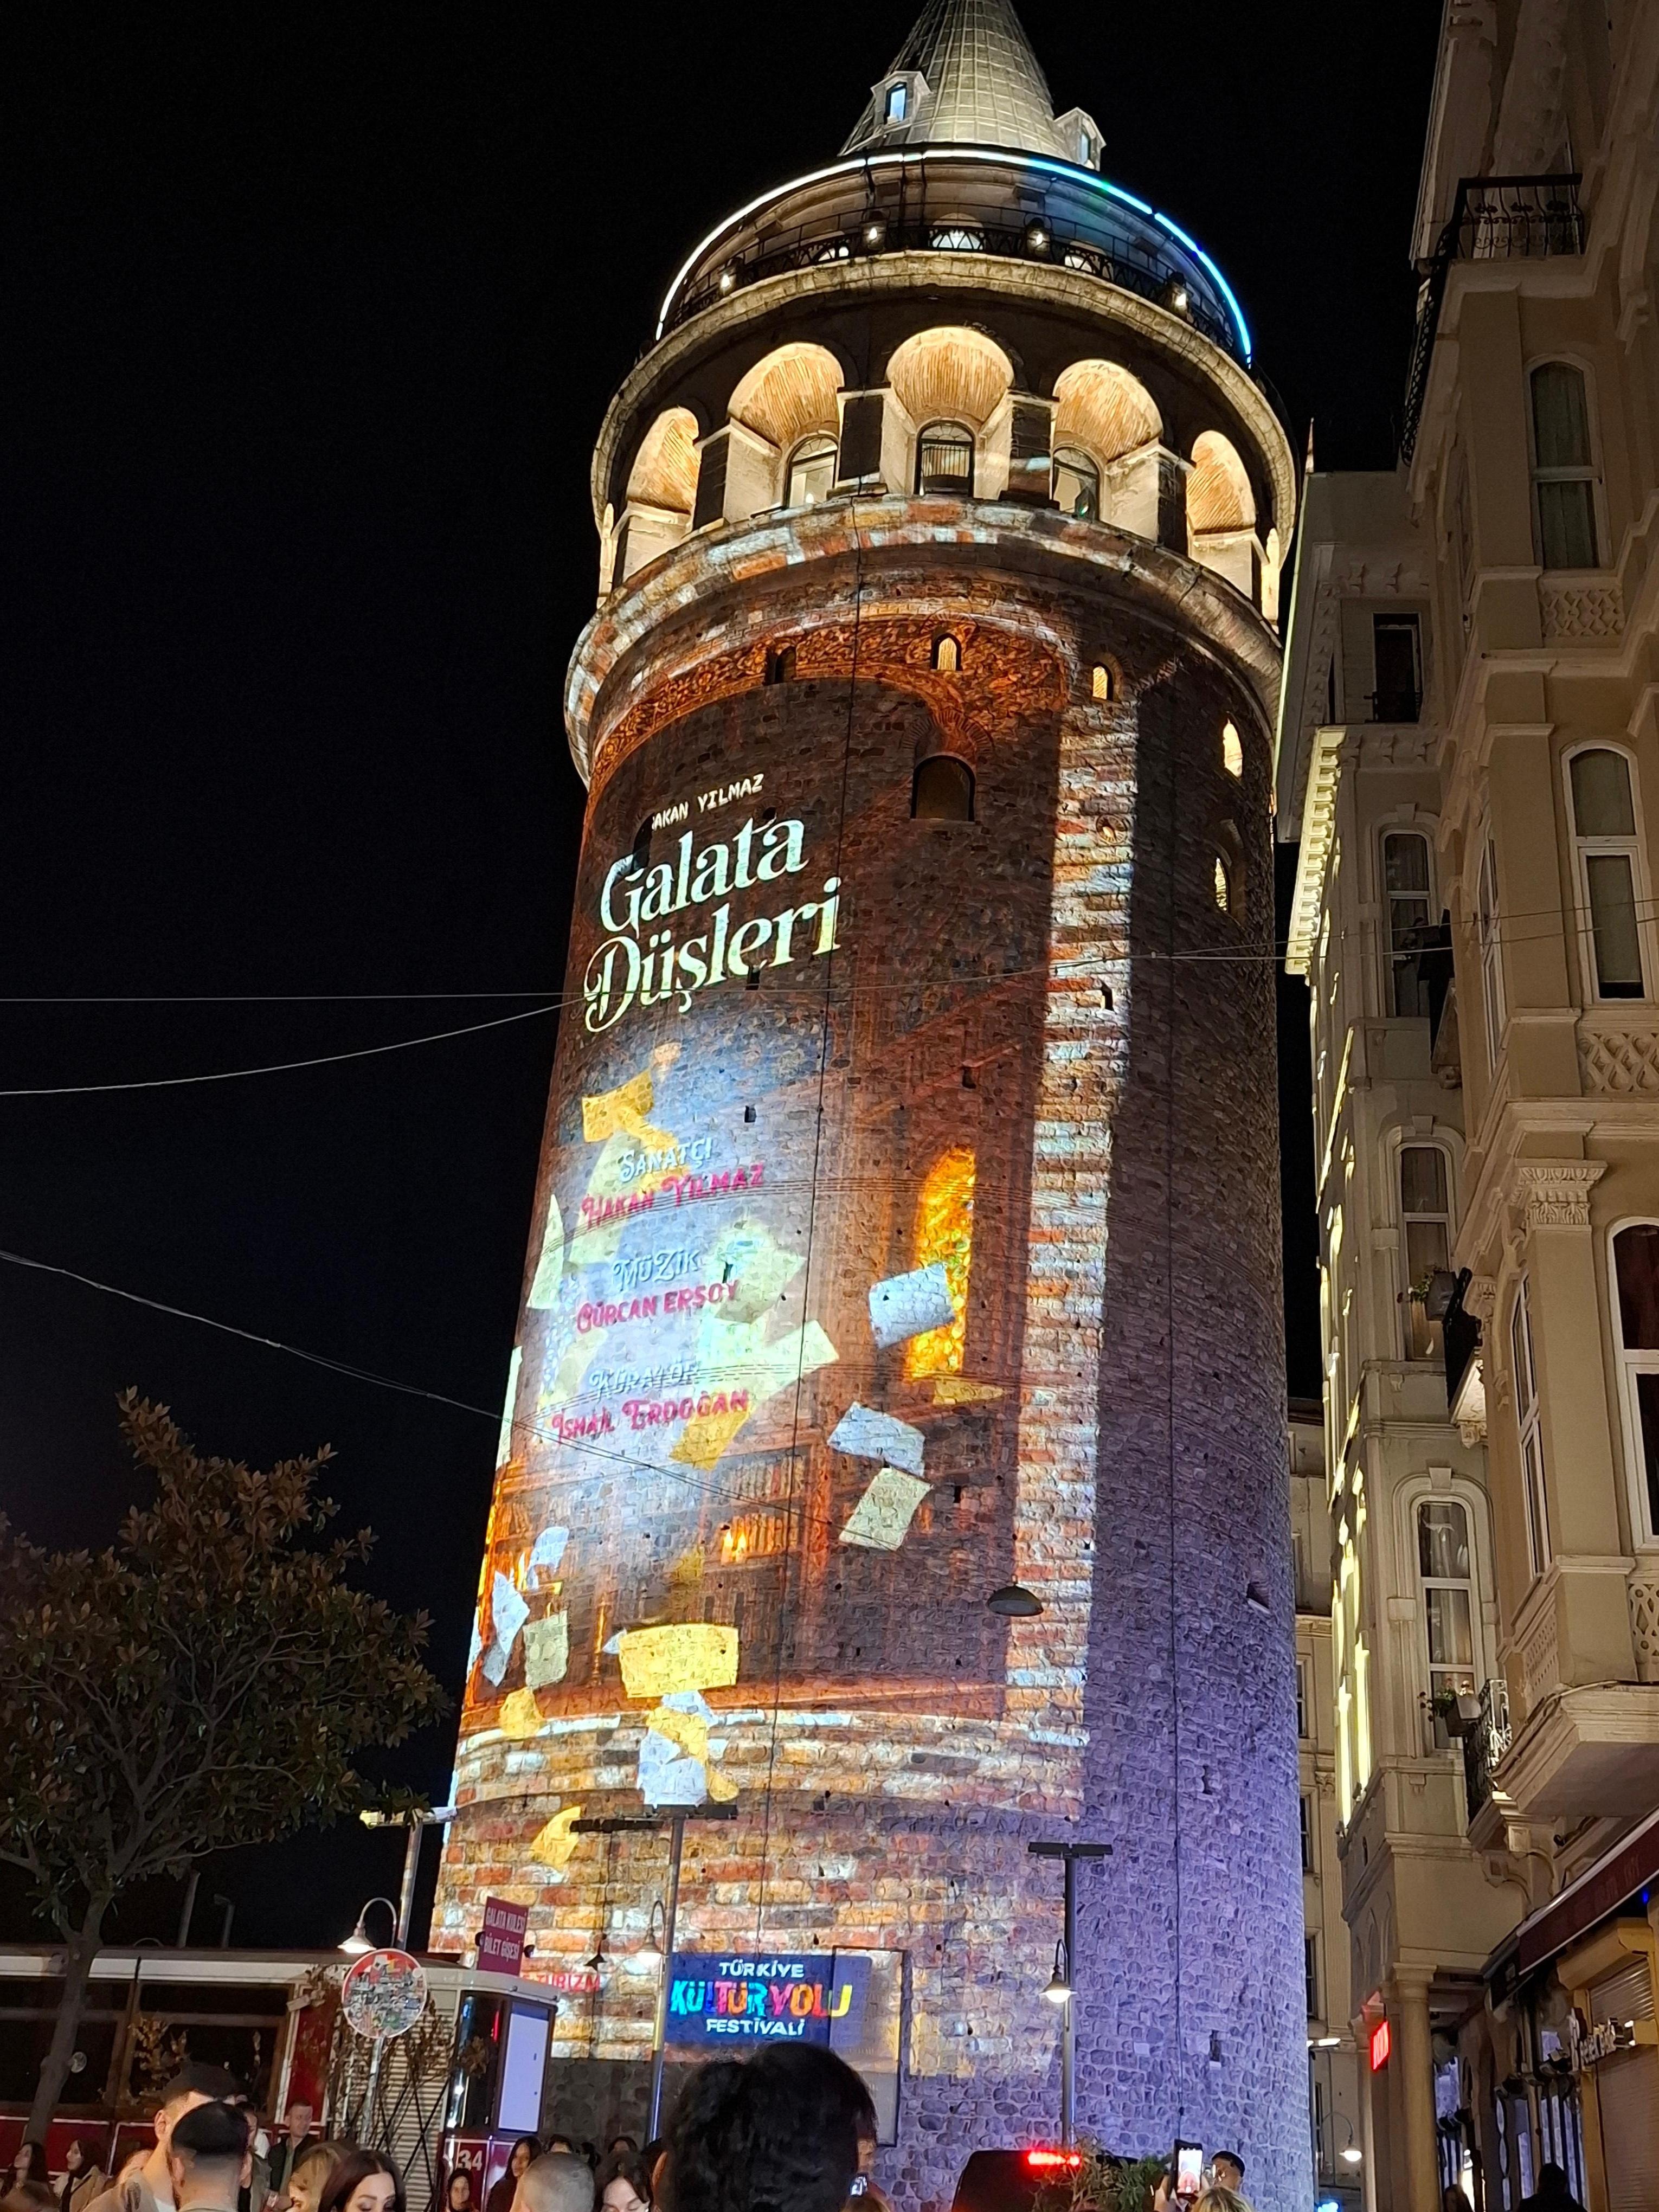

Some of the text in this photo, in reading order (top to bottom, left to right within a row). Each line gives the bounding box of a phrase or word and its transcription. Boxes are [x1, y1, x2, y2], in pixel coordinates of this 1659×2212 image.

[697, 774, 764, 813] YILMAZ
[600, 818, 809, 938] Galata
[584, 877, 841, 1032] Düşleri
[661, 1161, 764, 1208] YILMAZ
[664, 1279, 740, 1314] ERSOY
[719, 1959, 805, 1978] TÜRKİYE
[670, 1980, 852, 2018] KÜLTÜR YOLU
[706, 2017, 805, 2035] FESTİVALİ
